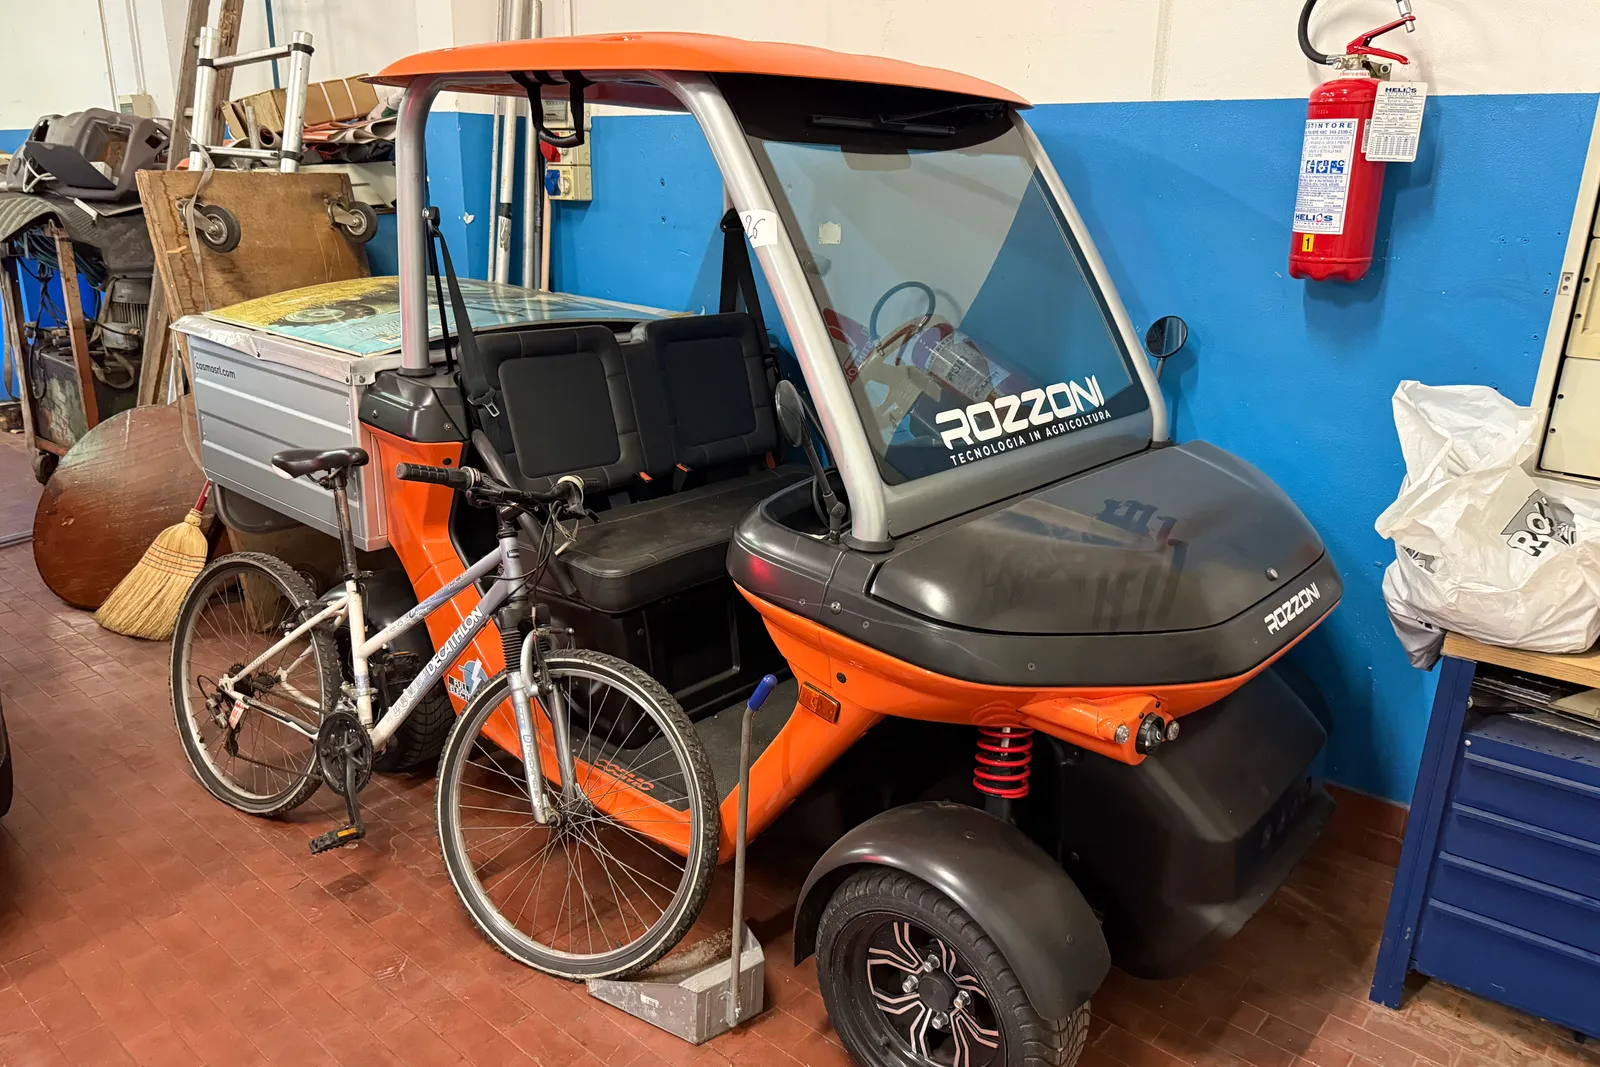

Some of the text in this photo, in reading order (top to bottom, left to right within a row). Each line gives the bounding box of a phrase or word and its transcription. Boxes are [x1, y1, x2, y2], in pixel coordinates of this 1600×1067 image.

[1295, 213, 1333, 223] HELIOS
[1305, 237, 1311, 250] 1
[935, 374, 1105, 450] ROZZONI
[950, 409, 1112, 466] TECNOLOGIA IN AGRICOLTURA
[1263, 581, 1321, 635] ROZZONI
[426, 605, 485, 677] DECATHLON
